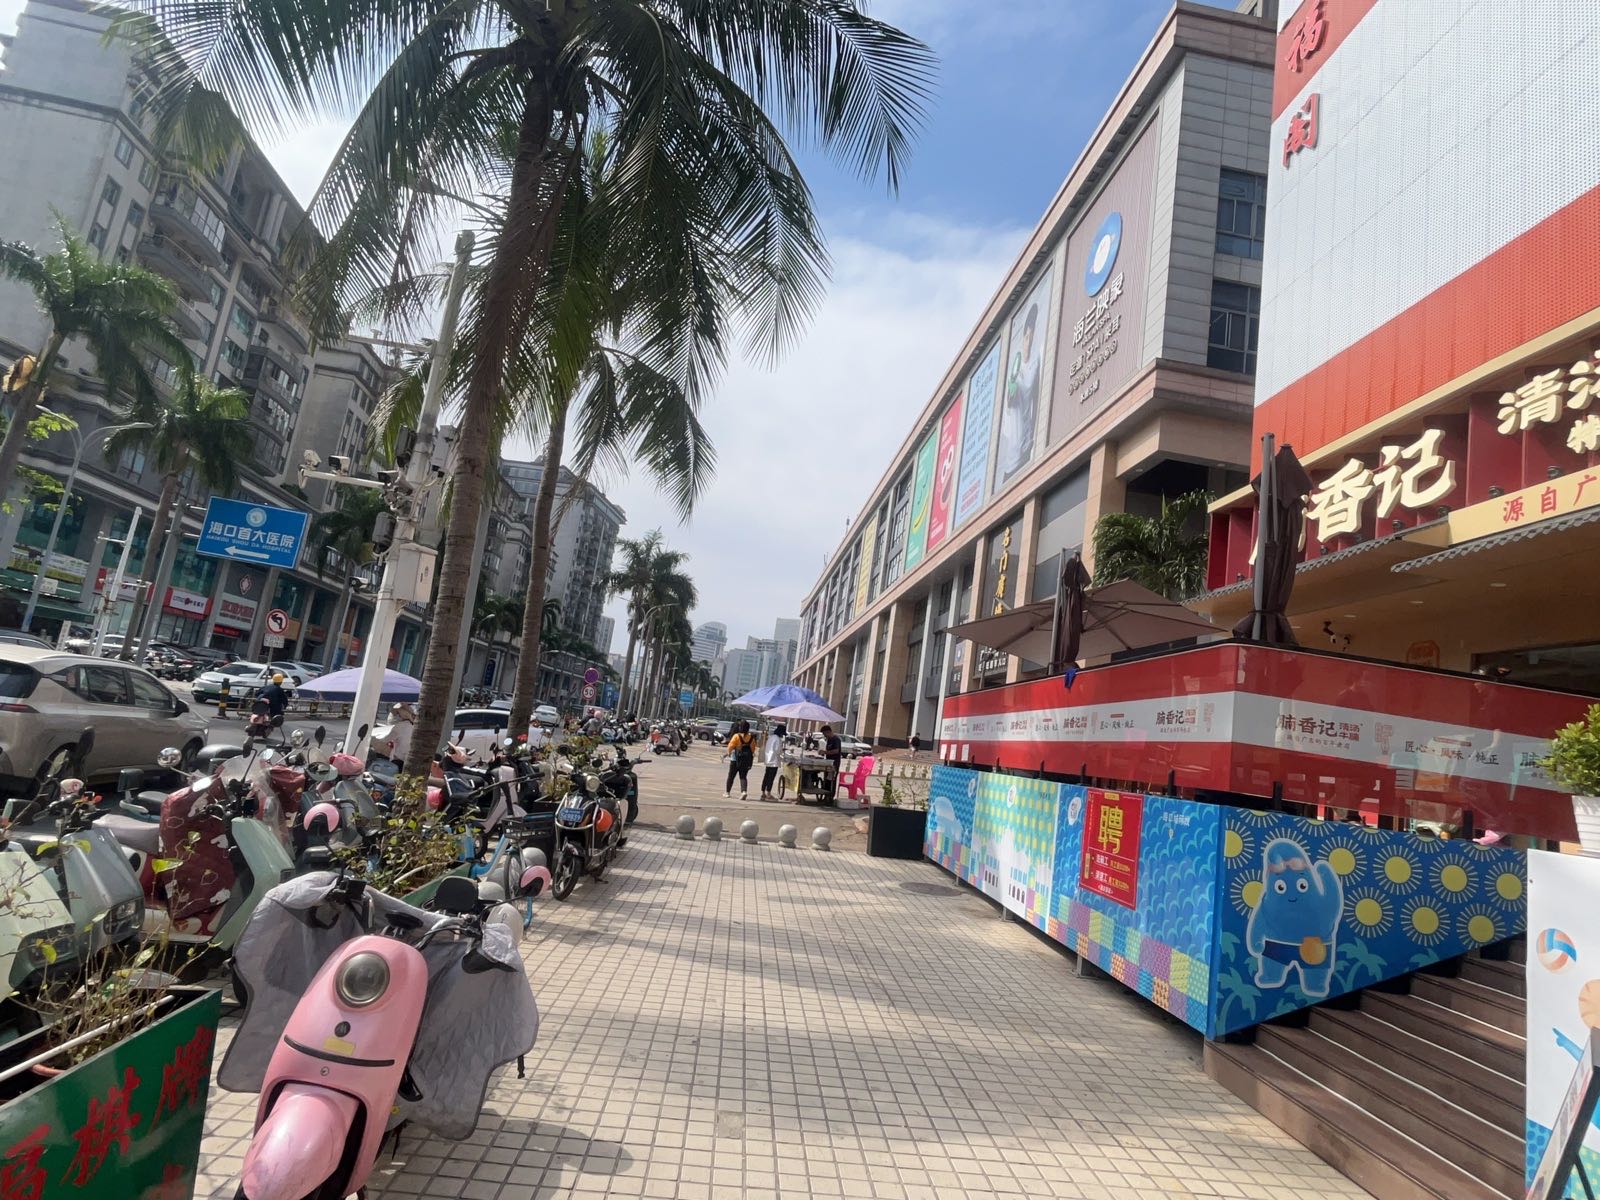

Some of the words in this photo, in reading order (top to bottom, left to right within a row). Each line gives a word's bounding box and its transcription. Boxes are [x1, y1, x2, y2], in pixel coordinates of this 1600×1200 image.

[1249, 428, 1457, 566] 香记
[1503, 474, 1597, 524] 源自广
[208, 520, 295, 549] 海口首大医院
[232, 538, 250, 547] SHOU
[262, 545, 291, 554] HOSPITAL
[584, 688, 594, 696] 50
[1275, 714, 1338, 738] 腩香记
[1098, 805, 1124, 854] 聘
